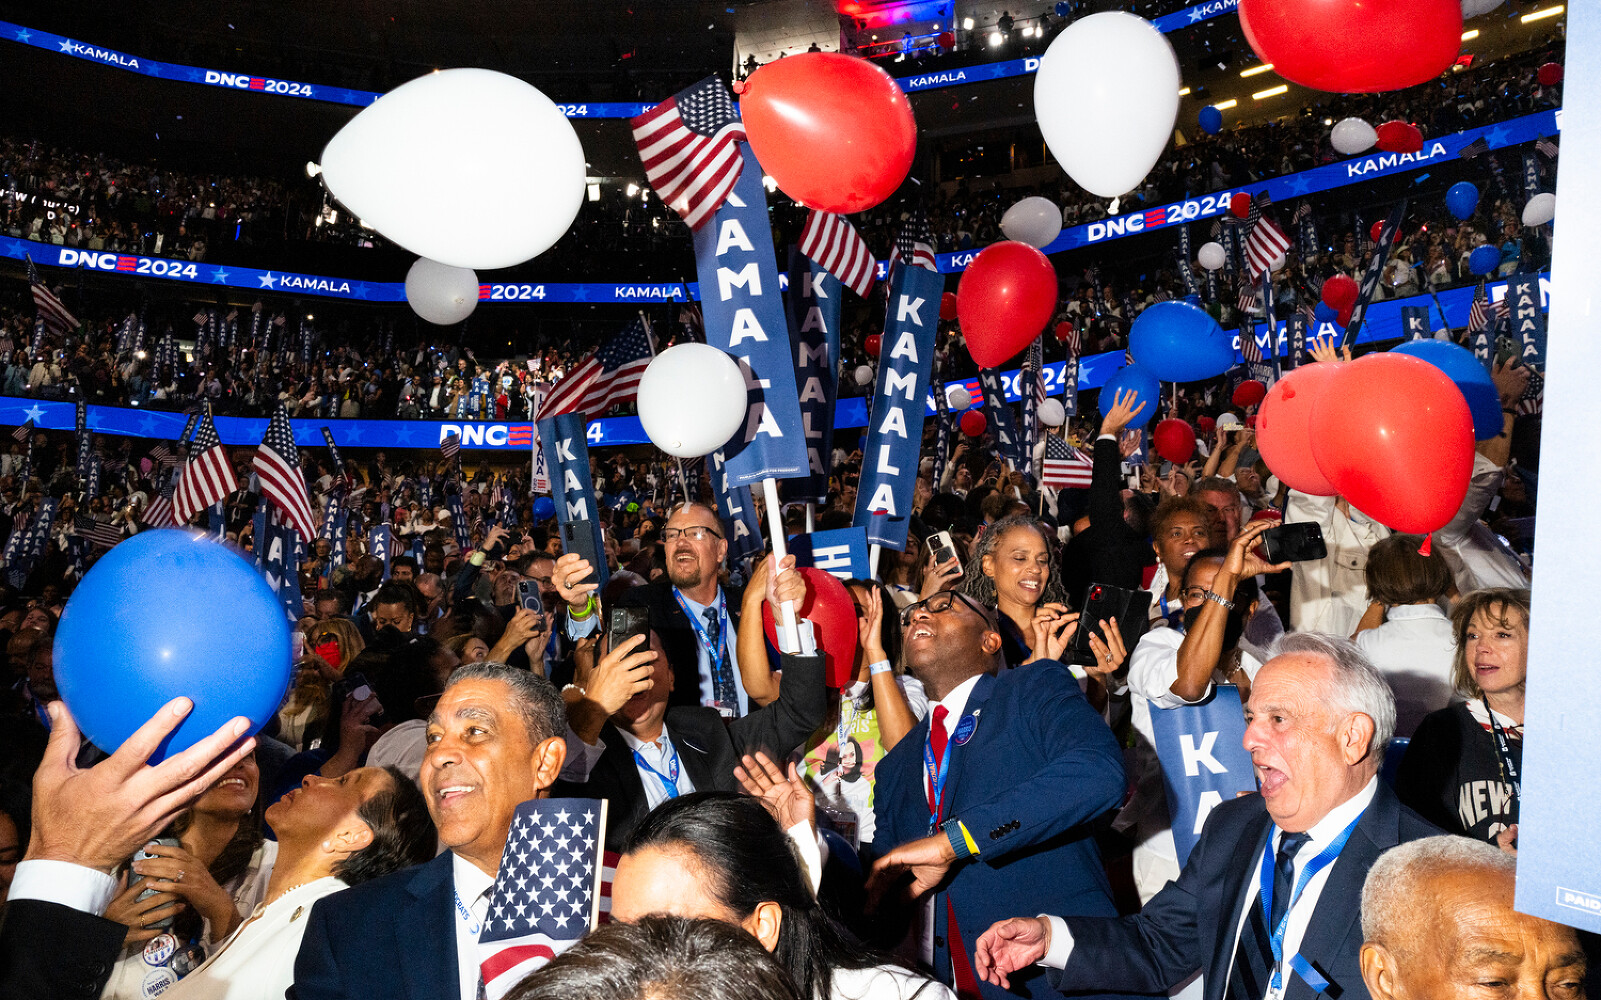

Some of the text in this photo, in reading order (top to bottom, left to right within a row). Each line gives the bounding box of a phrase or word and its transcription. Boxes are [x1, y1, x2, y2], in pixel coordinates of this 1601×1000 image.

[1203, 0, 1240, 15] KAM
[74, 43, 139, 69] KAMALA
[205, 70, 313, 97] DNC 2024
[910, 70, 966, 88] KAMALA
[558, 104, 588, 116] 024
[1347, 142, 1447, 178] KAMALA
[1524, 158, 1537, 190] KAMA
[1088, 192, 1232, 242] DNC 2024
[59, 248, 198, 279] DNC 2024
[280, 276, 350, 294] KAMALA
[490, 284, 546, 300] 2024
[615, 286, 682, 299] KAMALA
[714, 190, 784, 444] AMALA
[1516, 282, 1538, 357] KAMALA
[1294, 321, 1303, 368] KAMAL
[798, 271, 829, 475] KAMALA
[1065, 357, 1077, 409] AMALA
[457, 398, 465, 419] KAMA
[867, 294, 926, 517] KAMALA
[981, 372, 1012, 445] MALA
[440, 424, 508, 446] DNC
[89, 461, 98, 499] KAMAL
[554, 437, 590, 522] KAM
[31, 504, 53, 556] KAMALA
[334, 527, 343, 566] KAM
[374, 532, 386, 561] KAM
[1458, 779, 1513, 830] NEW
[1565, 891, 1600, 909] PAID
